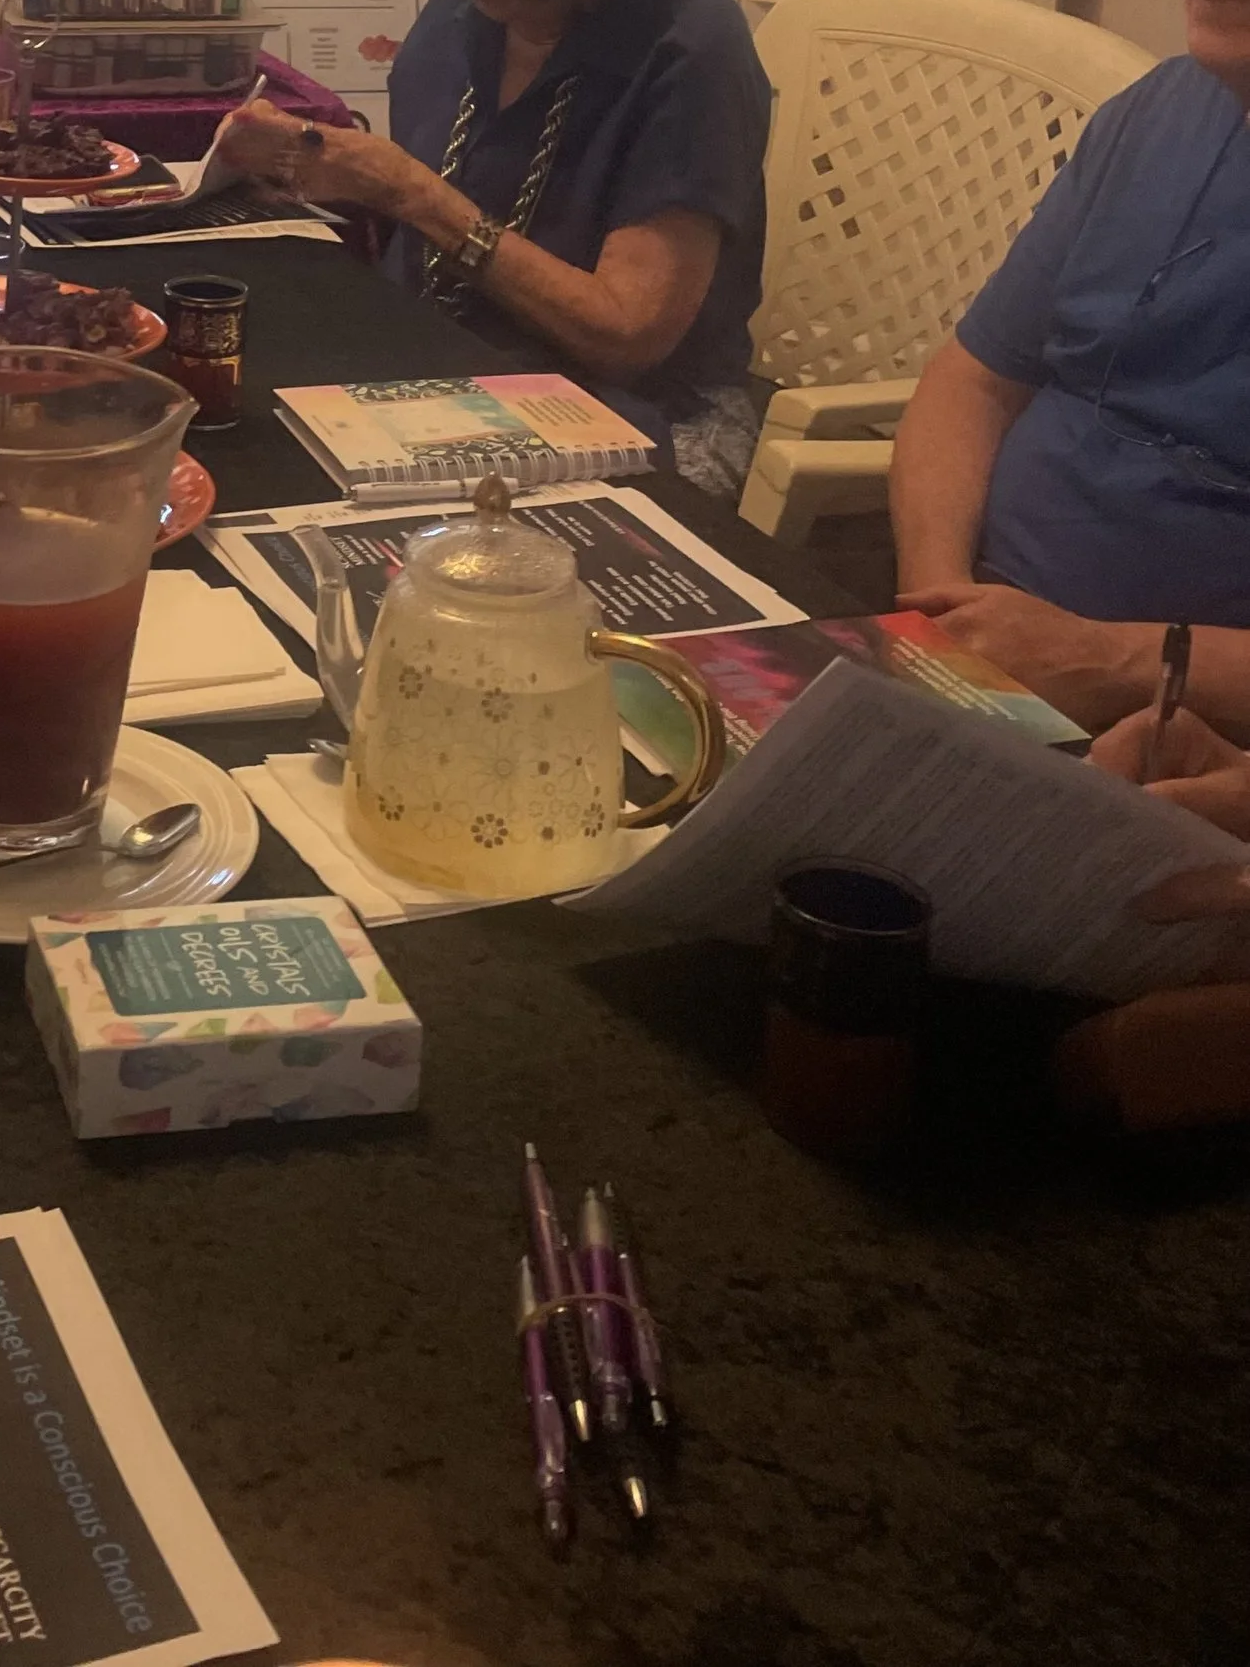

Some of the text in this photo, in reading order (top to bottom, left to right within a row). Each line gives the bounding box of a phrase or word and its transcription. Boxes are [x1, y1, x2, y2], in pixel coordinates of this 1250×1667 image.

[180, 931, 232, 998] DECREES
[218, 927, 270, 997] OILS AND
[251, 922, 311, 998] CRYSTALS
[13, 1363, 42, 1385] is
[23, 1390, 47, 1405] a
[34, 1410, 106, 1538] Conscious
[92, 1542, 151, 1634] Choice
